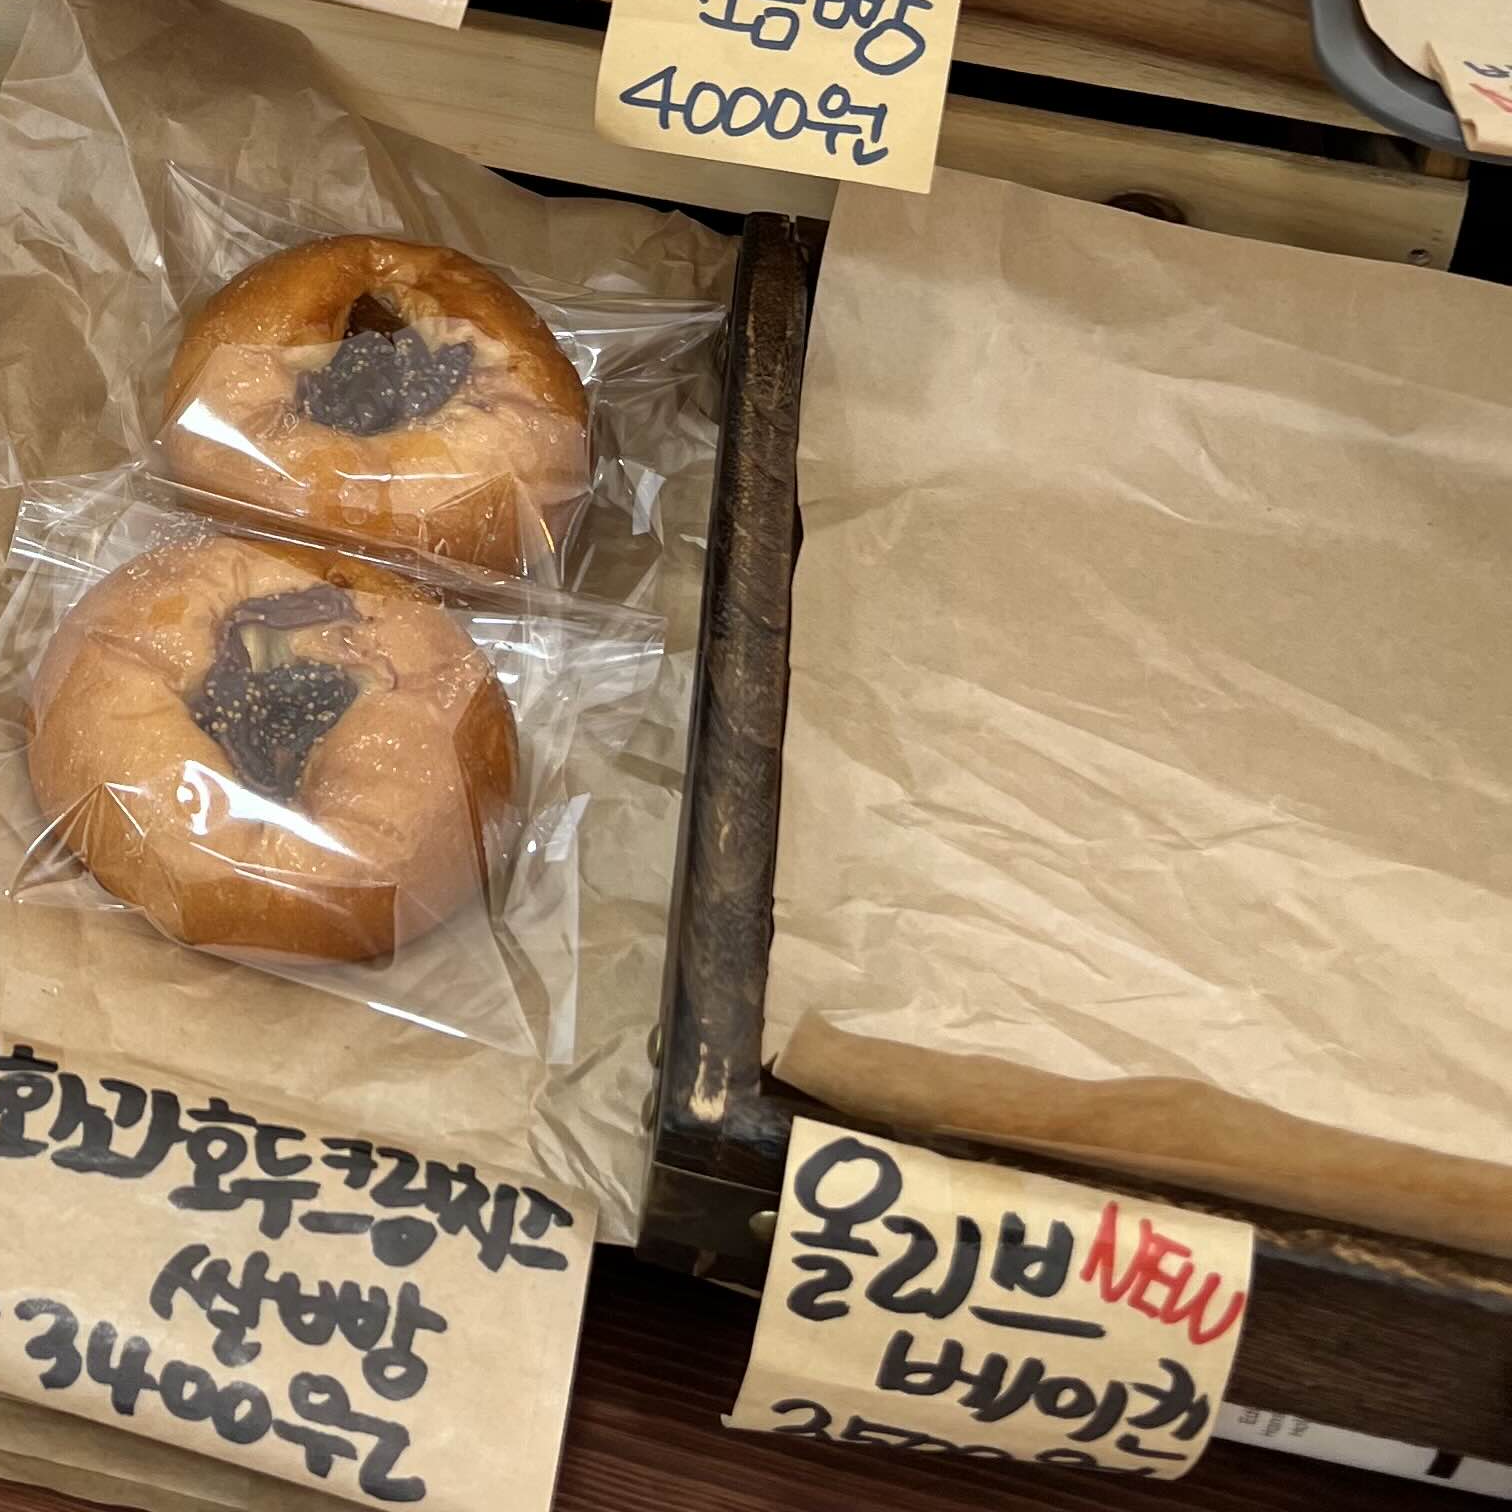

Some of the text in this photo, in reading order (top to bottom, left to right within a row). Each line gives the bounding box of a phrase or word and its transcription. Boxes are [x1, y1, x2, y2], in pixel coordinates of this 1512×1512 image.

[620, 66, 888, 165] 4000원
[786, 1136, 1245, 1346] 올리브 NEW
[149, 1244, 447, 1400] 쌀빵
